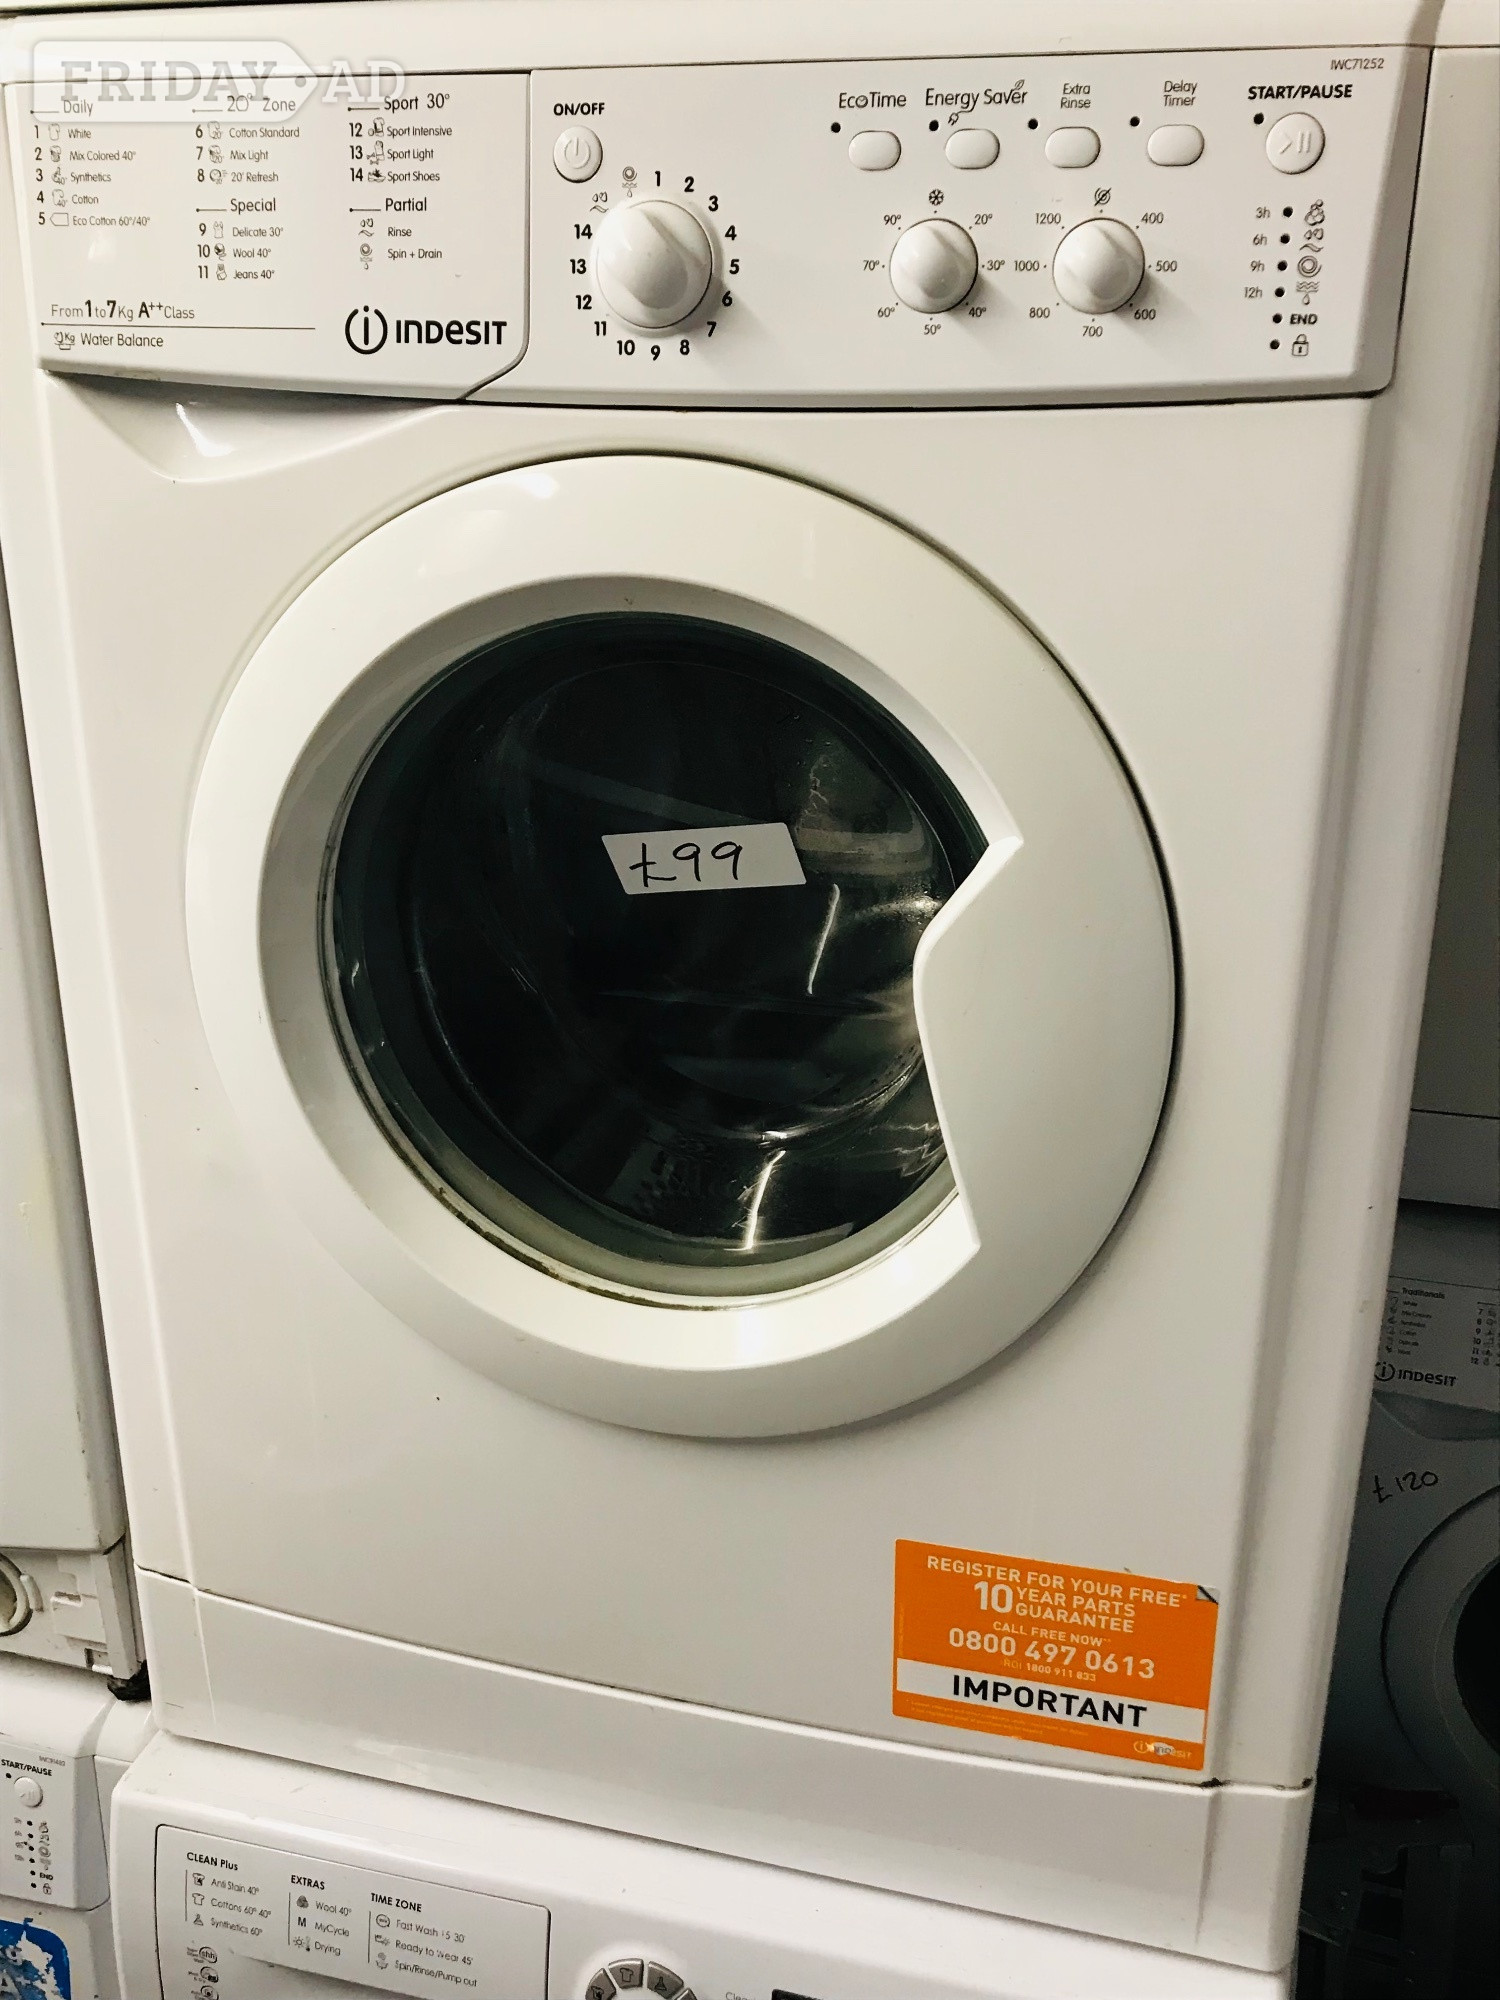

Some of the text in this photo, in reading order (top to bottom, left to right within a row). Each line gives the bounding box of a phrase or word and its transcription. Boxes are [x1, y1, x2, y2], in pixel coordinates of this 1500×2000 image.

[1330, 58, 1384, 70] IWC71252
[1062, 82, 1091, 95] Extra
[1164, 80, 1198, 96] Delay
[1248, 84, 1353, 100] START/PAUSE
[262, 98, 296, 112] Zone
[384, 96, 418, 114] Sport
[839, 92, 906, 109] EcoTime
[925, 88, 1028, 111] Energy Saver
[1060, 96, 1091, 108] Rinse
[1164, 94, 1196, 107] Timer
[63, 99, 94, 116] Daily
[552, 102, 606, 116] ON/OFF
[34, 125, 92, 139] 1 White
[196, 126, 300, 138] 6 Cotton Standard
[350, 122, 452, 138] 12 Sport Intensive
[34, 148, 42, 160] 2
[69, 150, 85, 160] Mix
[86, 150, 120, 160] Colored
[196, 146, 269, 162] 7 Mix Light
[350, 145, 434, 160] 13 Sport Light
[36, 169, 112, 184] 3 Synthetics
[197, 169, 205, 182] 8
[246, 172, 279, 182] Refresh
[350, 168, 440, 183] 14 Sport Shoes
[654, 171, 661, 187] 1
[684, 176, 694, 192] 2
[36, 191, 99, 204] 4 Cotton
[385, 197, 428, 212] Partial
[708, 195, 719, 212] 3
[230, 199, 276, 214] Special
[1256, 206, 1270, 219] 3h
[38, 212, 46, 225] 5
[72, 216, 88, 226] Eco
[90, 216, 116, 226] Cotton
[1035, 212, 1062, 224] 1200
[1141, 212, 1164, 224] 400
[199, 223, 206, 236] 9
[232, 227, 266, 238] Delicate
[388, 226, 412, 237] Rinse
[574, 224, 592, 240] 14
[725, 225, 737, 240] 4
[1252, 234, 1267, 246] 6h
[198, 244, 210, 258] 10
[232, 248, 255, 258] Wool
[388, 249, 408, 260] Spin
[418, 249, 442, 259] Drain
[198, 266, 208, 279] 11
[233, 269, 258, 280] Jeans
[570, 258, 586, 274] 13
[729, 259, 740, 274] 5
[1014, 260, 1040, 272] 1000
[1155, 260, 1178, 272] 500
[1250, 260, 1265, 272] 9h
[722, 290, 732, 306] 6
[1244, 286, 1262, 299] 12h
[576, 294, 592, 310] 12
[51, 304, 84, 318] From
[118, 306, 134, 322] Kg
[164, 306, 195, 320] Class
[1029, 308, 1050, 319] 800
[1134, 308, 1156, 320] 600
[1290, 314, 1318, 325] END
[396, 320, 508, 345] INDESIT
[594, 320, 606, 336] 11
[706, 321, 716, 338] 7
[1082, 326, 1103, 338] 700
[80, 333, 164, 348] Water Balance
[616, 340, 636, 356] 10
[680, 339, 690, 356] 8
[650, 345, 660, 361] 9
[629, 841, 742, 888] £99
[1398, 1369, 1458, 1387] INDESIT
[927, 1555, 1020, 1583] REGISTER
[1026, 1572, 1065, 1590] FOR
[1070, 1578, 1122, 1598] YOUR
[974, 1580, 1136, 1617] 10 YEAR PARTS
[1016, 1602, 1134, 1633] GUARANTEE
[992, 1620, 1028, 1636] CALL
[1031, 1627, 1066, 1642] FREE
[949, 1628, 1155, 1680] 0800 497 0613
[1026, 1662, 1052, 1674] 1800
[1054, 1667, 1073, 1678] 911
[952, 1674, 1147, 1728] IMPORTANT
[1, 1758, 52, 1777] START/PAUSE
[186, 1852, 238, 1871] CLEAN Plus
[290, 1874, 326, 1890] EXTRAS
[210, 1898, 242, 1912] Cottons
[316, 1900, 337, 1914] Wool
[371, 1892, 422, 1913] TIME ZONE
[211, 1917, 249, 1934] Synthetics
[298, 1916, 350, 1937] M MyCycle
[396, 1919, 413, 1932] Fast
[416, 1924, 439, 1937] Wash
[314, 1940, 341, 1957] Drying
[395, 1940, 424, 1956] Ready
[425, 1947, 435, 1957] to
[464, 1978, 478, 1987] out
